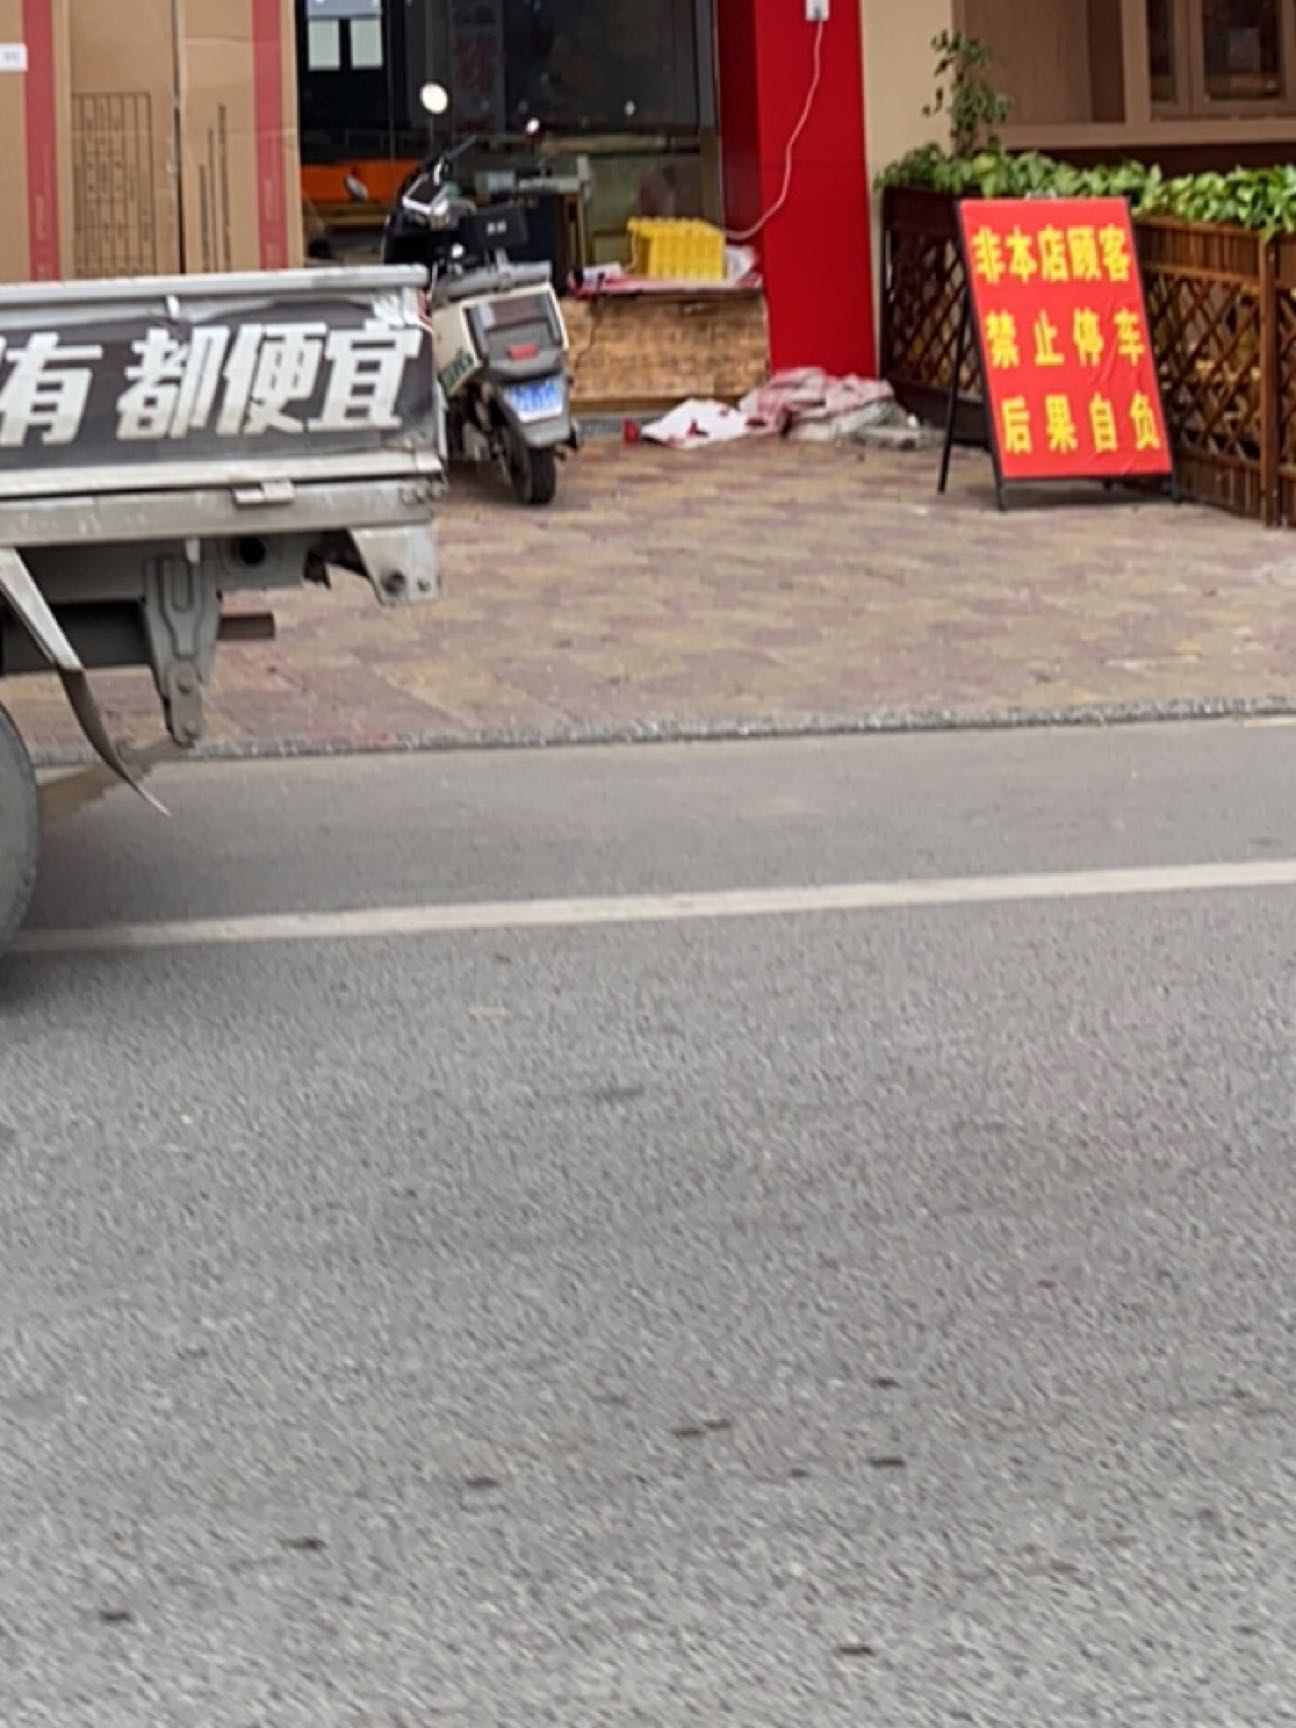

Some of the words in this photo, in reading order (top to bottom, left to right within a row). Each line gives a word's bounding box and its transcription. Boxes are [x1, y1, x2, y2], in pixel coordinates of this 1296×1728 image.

[971, 223, 1132, 284] 非本店顾客
[985, 307, 1145, 369] 禁止停车
[115, 322, 423, 442] 都便宜
[1000, 391, 1160, 455] 后果自负
